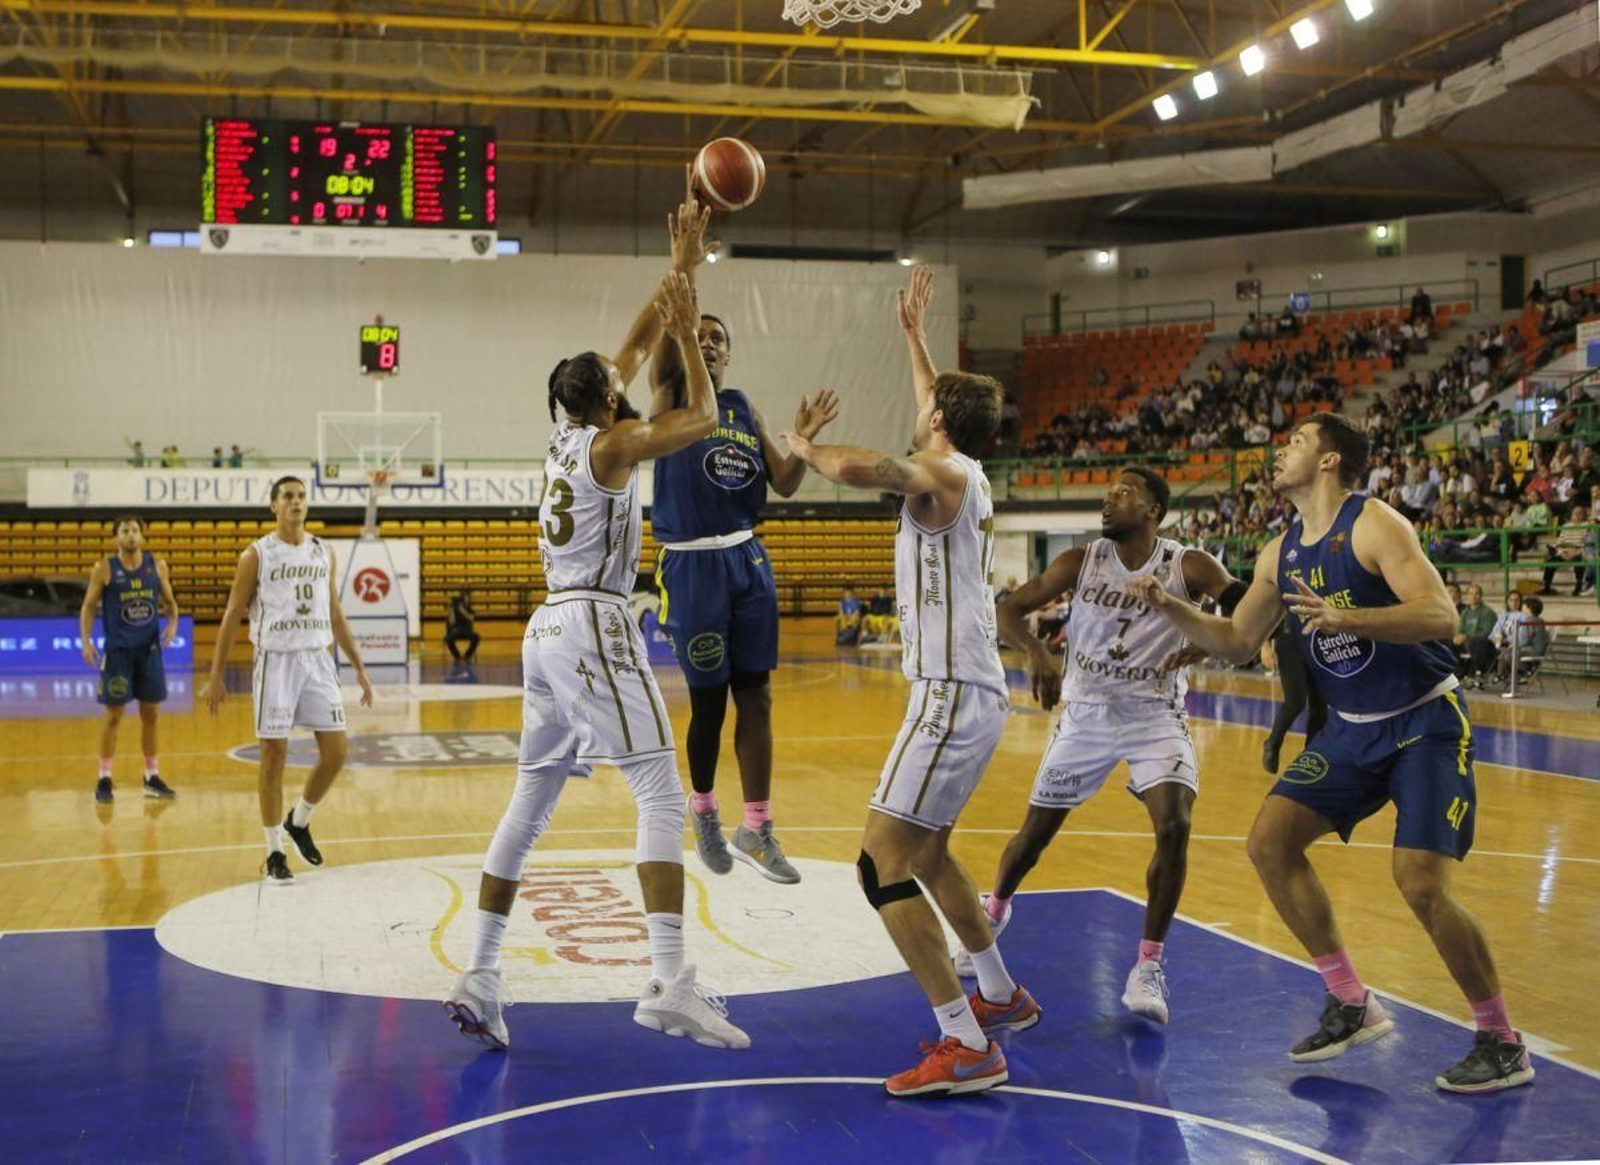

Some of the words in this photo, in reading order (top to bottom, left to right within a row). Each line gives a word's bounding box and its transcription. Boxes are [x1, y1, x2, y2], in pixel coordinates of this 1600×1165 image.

[368, 139, 391, 159] 22
[344, 153, 356, 170] 2
[326, 175, 374, 195] 08:04
[313, 202, 325, 218] 0
[375, 204, 387, 218] 4
[380, 343, 394, 367] 8
[728, 409, 734, 423] 1
[1514, 447, 1522, 466] 2
[1310, 565, 1325, 590] 41
[295, 584, 313, 600] 10
[1117, 618, 1131, 638] 7
[1447, 797, 1469, 831] 41
